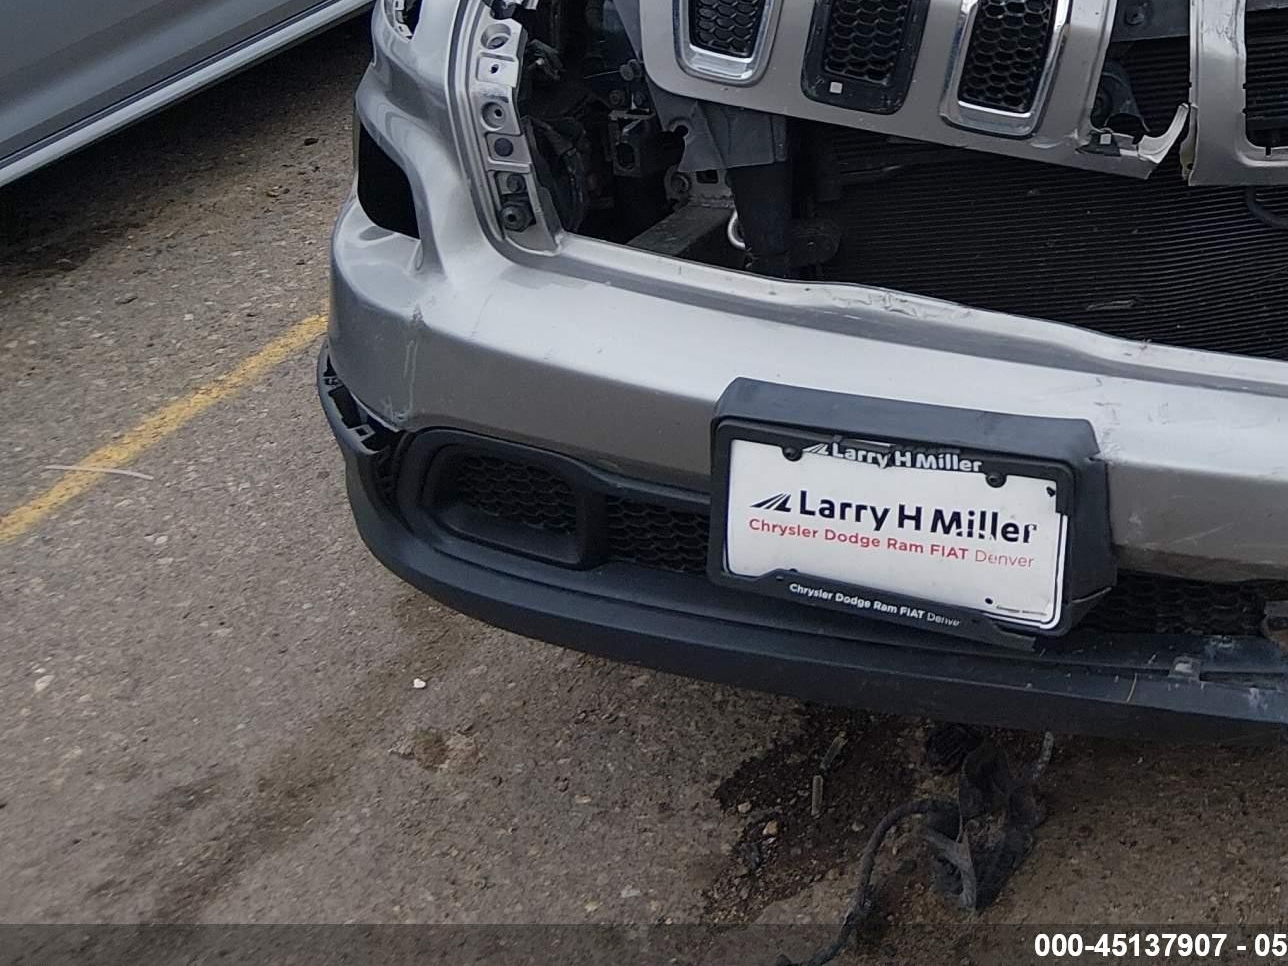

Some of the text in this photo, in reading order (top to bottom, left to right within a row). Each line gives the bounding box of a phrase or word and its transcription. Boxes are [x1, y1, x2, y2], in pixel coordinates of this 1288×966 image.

[832, 442, 984, 472] Larry H Miller
[799, 489, 1039, 544] Larry H Miller
[749, 518, 1035, 568] Chrysler Dodge Ram FIAT Denver
[789, 583, 834, 601] Chrysler
[835, 592, 871, 609] Dodge
[873, 601, 898, 614] Ram
[900, 606, 925, 620] FIAT
